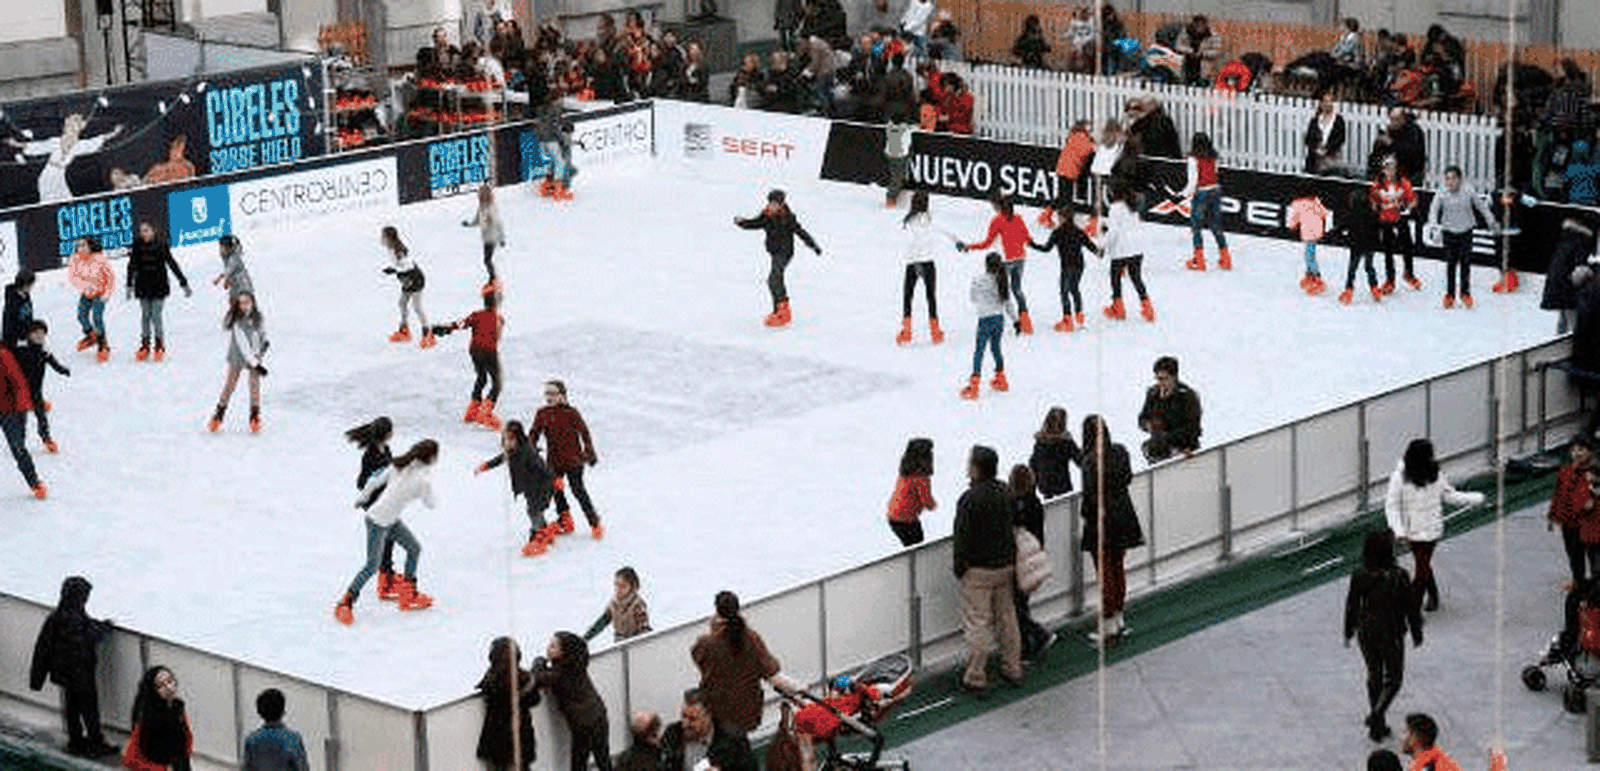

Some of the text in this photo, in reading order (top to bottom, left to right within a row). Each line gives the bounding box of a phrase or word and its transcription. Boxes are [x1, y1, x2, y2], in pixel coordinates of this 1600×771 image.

[206, 79, 301, 148] CIBELES
[721, 135, 796, 160] SEAT
[907, 153, 992, 190] NUEVO
[57, 196, 133, 241] CIBELES
